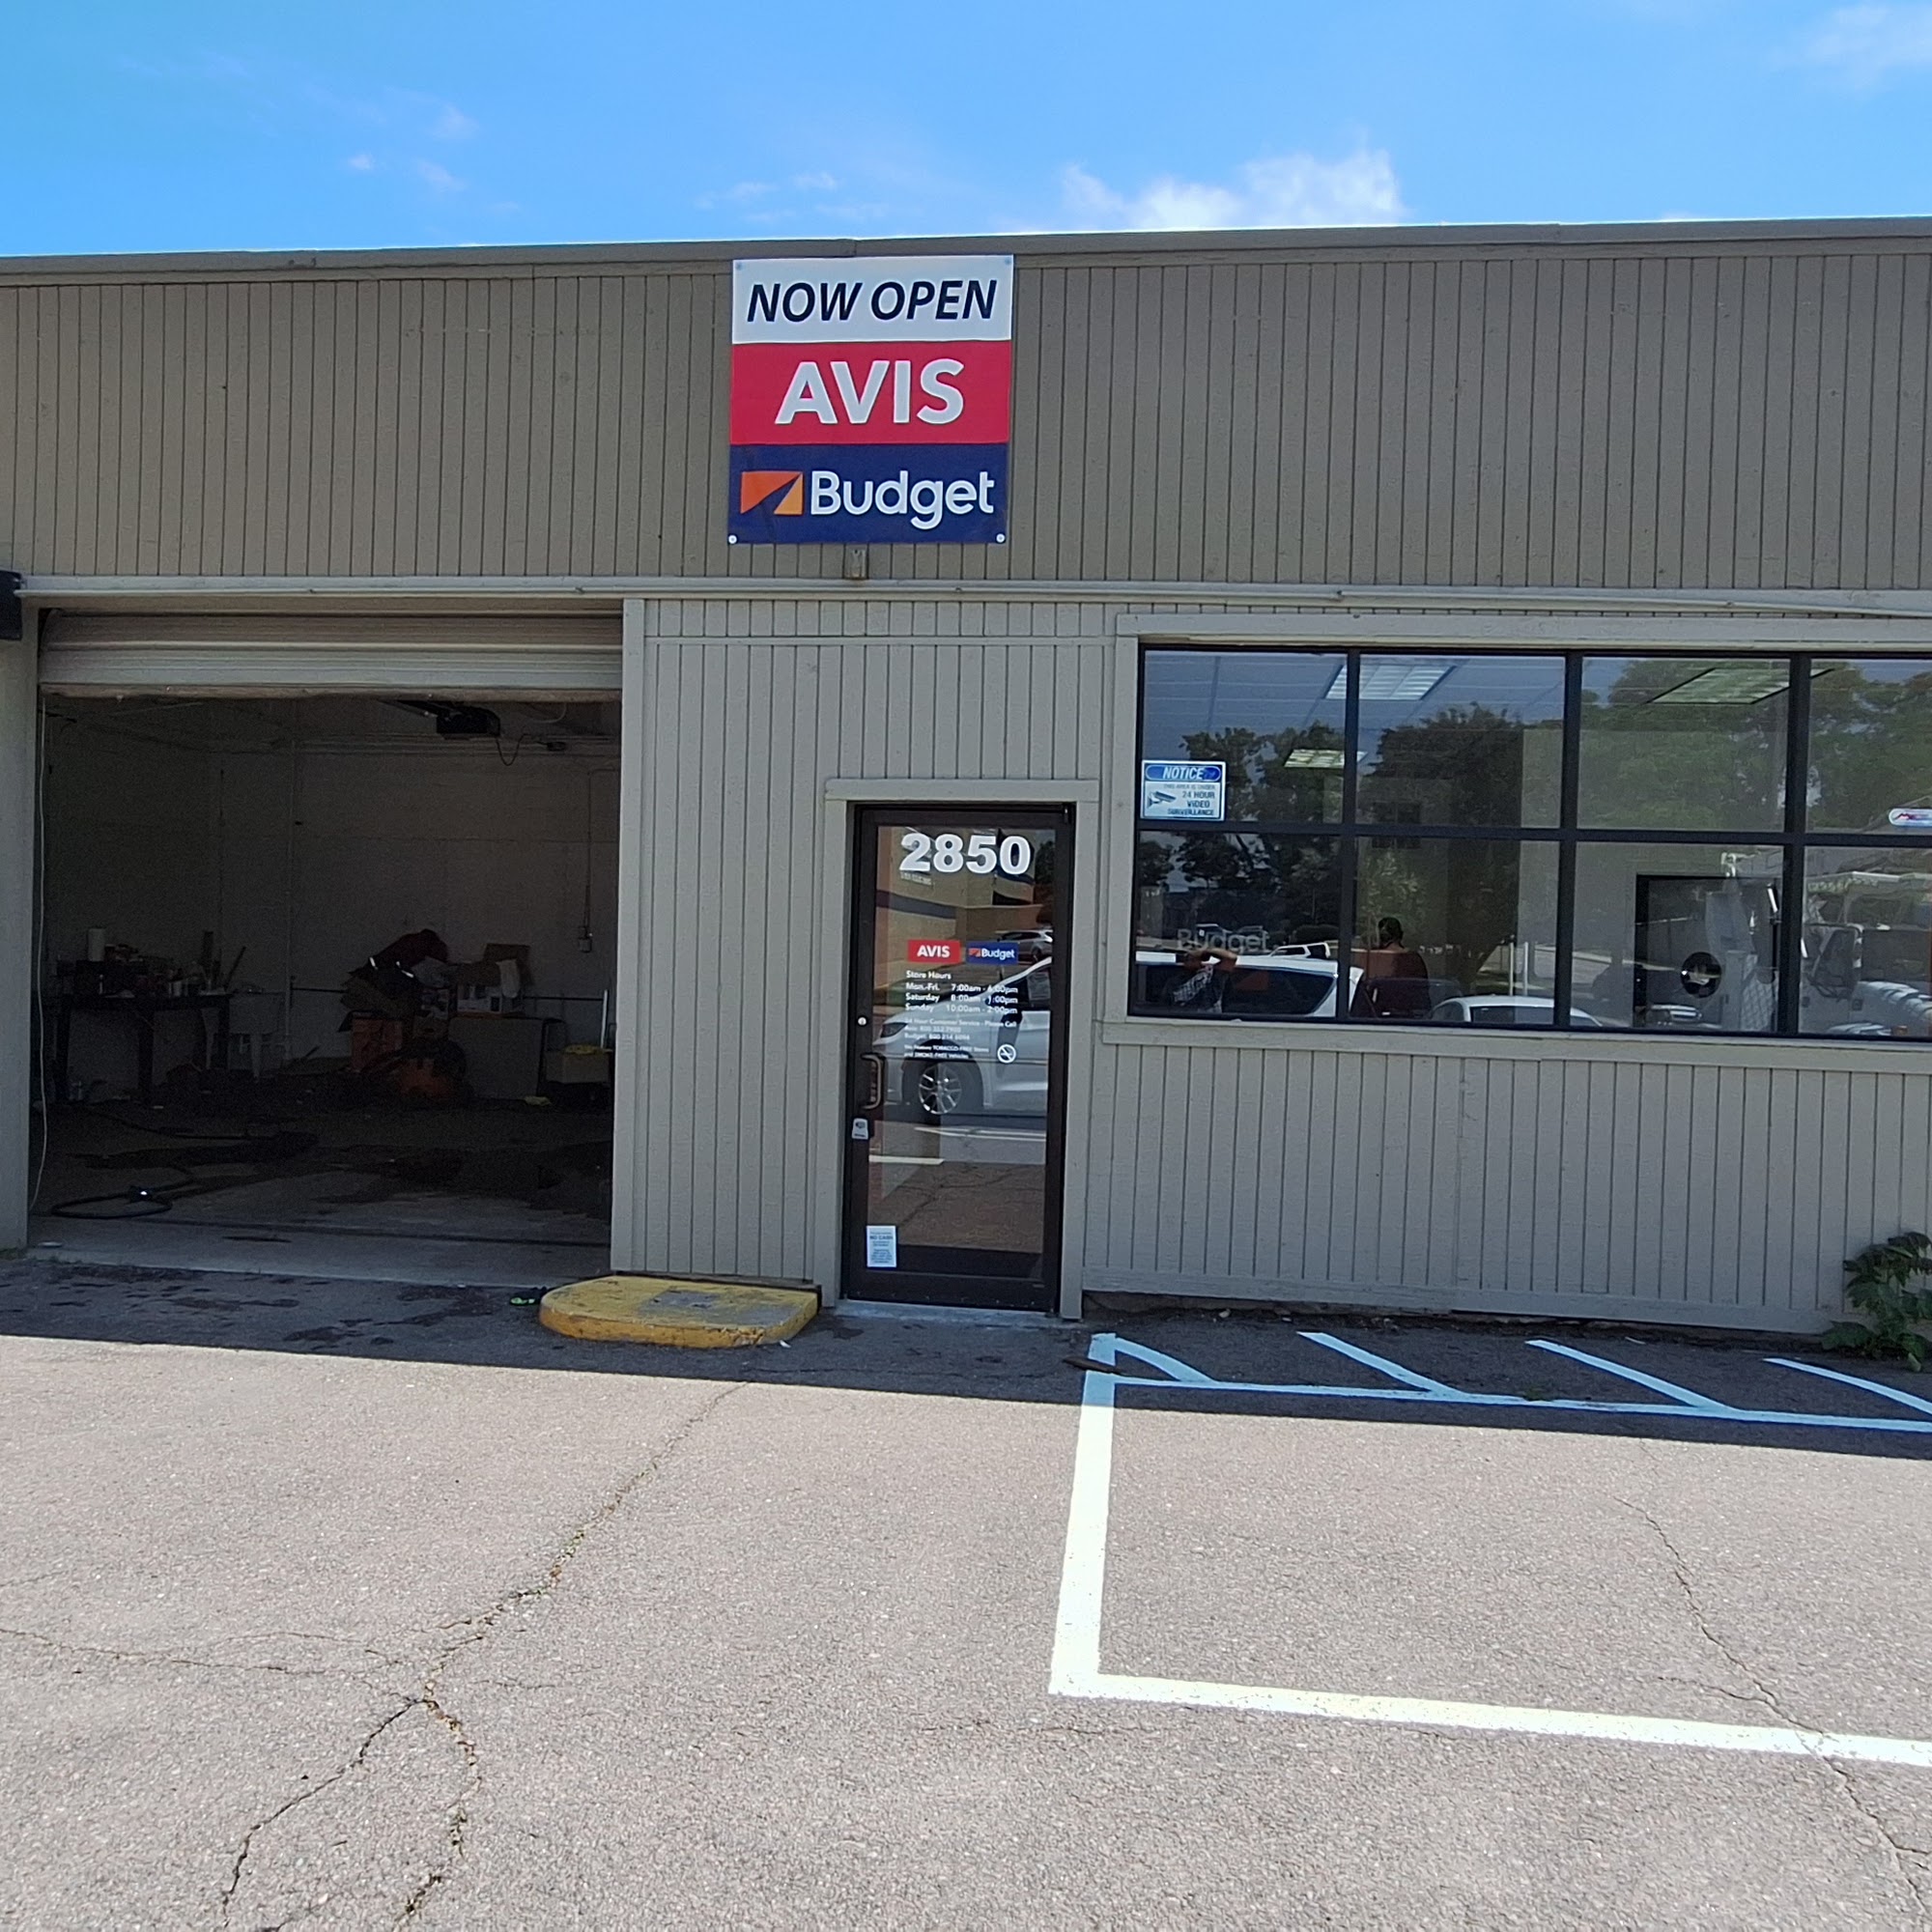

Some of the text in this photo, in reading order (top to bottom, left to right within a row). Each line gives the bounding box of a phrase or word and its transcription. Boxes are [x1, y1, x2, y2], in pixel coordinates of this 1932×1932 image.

[747, 279, 997, 322] NOW OPEN
[775, 358, 964, 424] AVIS
[810, 470, 994, 529] Budget
[1162, 767, 1205, 780] NOTICE
[899, 833, 1031, 875] 2850
[917, 945, 951, 958] AVIS
[981, 948, 1015, 960] Budget
[906, 970, 952, 980] Store Hours
[905, 992, 940, 1003] Saturday
[905, 1003, 934, 1013] Sunday
